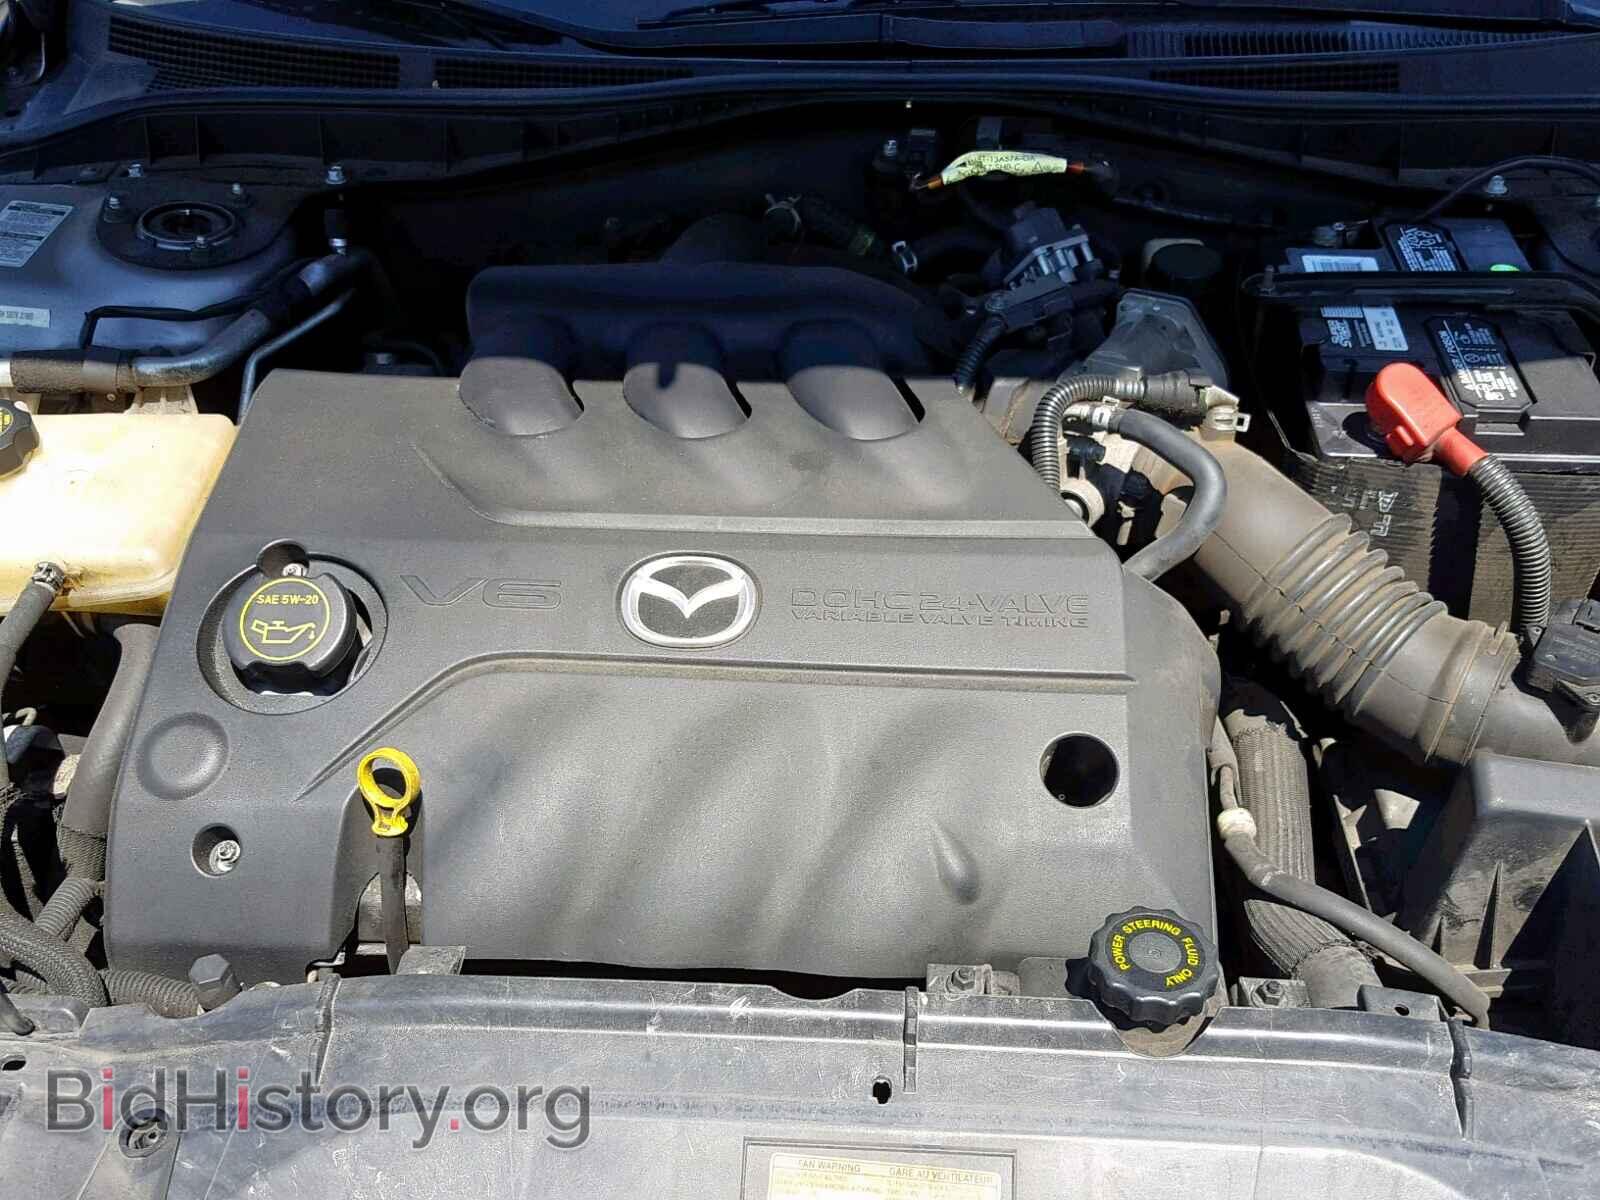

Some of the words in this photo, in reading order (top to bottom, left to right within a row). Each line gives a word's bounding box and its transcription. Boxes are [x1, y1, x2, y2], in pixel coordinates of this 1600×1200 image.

[256, 594, 279, 605] SAE
[281, 594, 319, 605] 5W-20
[400, 574, 562, 609] V6
[791, 588, 912, 610] DOHC
[918, 592, 1088, 614] 24-VALVE
[791, 609, 914, 623] VARIABLE
[918, 614, 993, 625] VALVE
[1000, 615, 1088, 628] TIMING
[1122, 919, 1182, 936] STEERING
[1112, 934, 1130, 970] POWER
[1182, 937, 1199, 966] FLUID
[1165, 968, 1192, 987] ONLY
